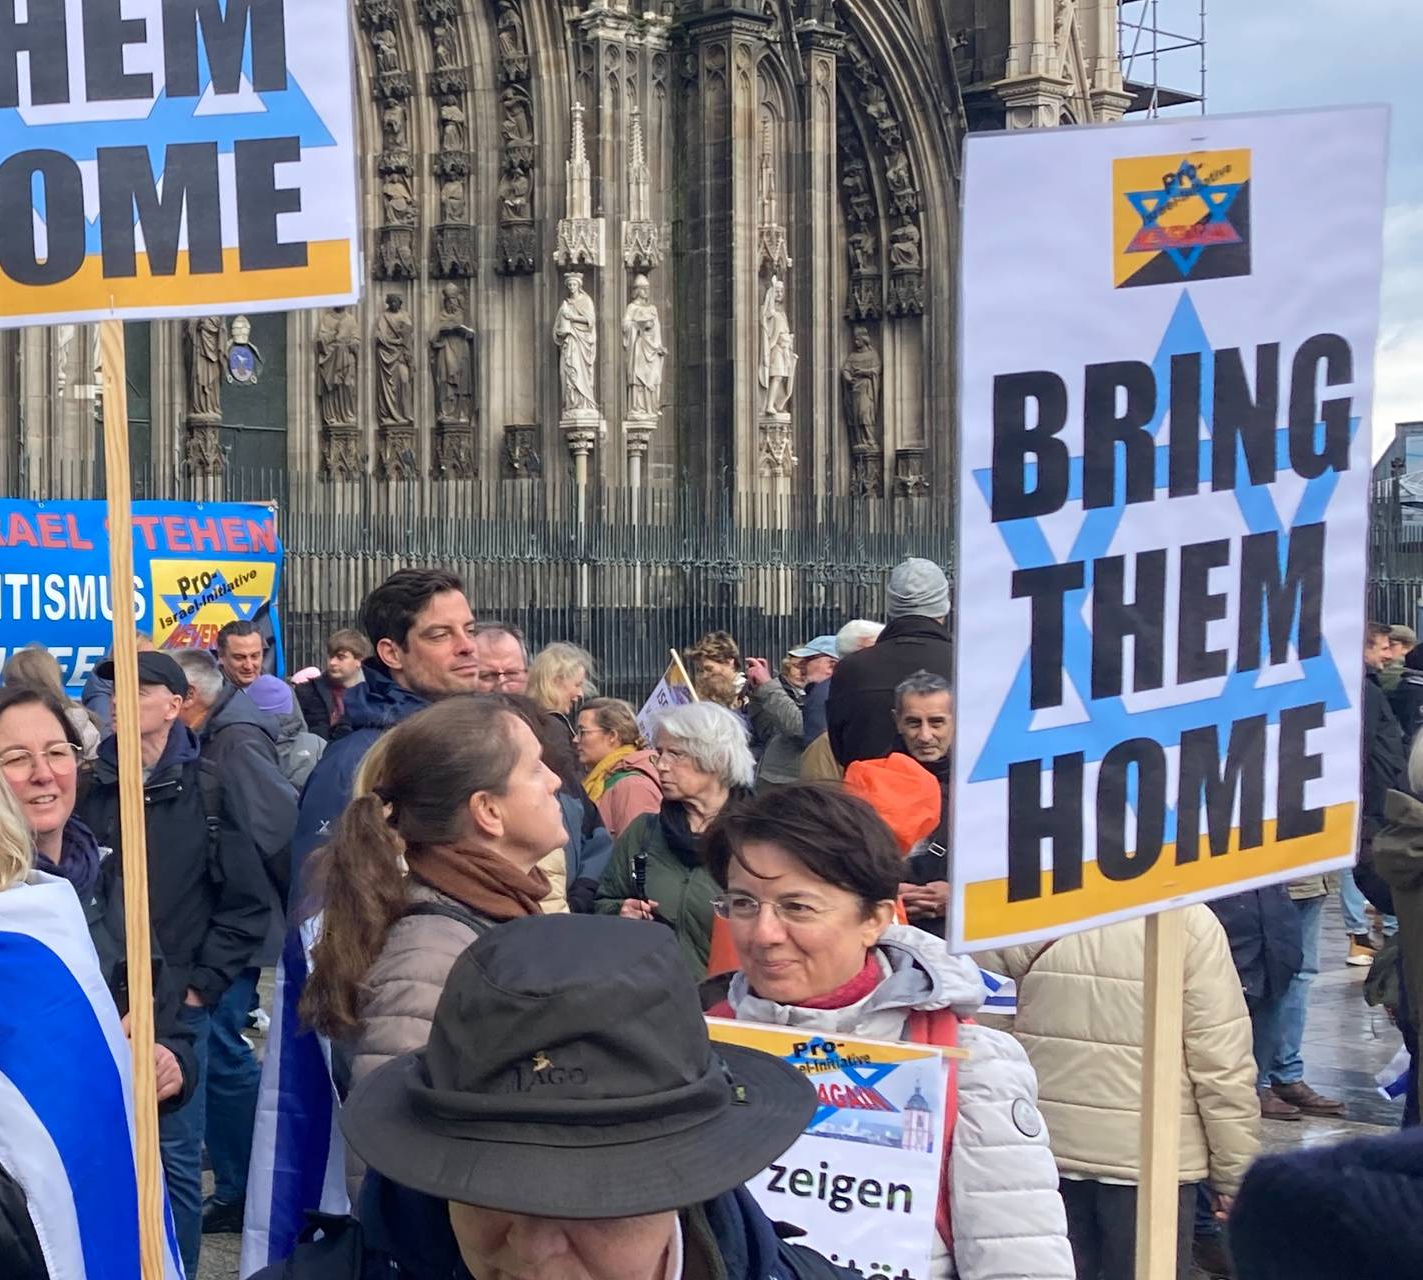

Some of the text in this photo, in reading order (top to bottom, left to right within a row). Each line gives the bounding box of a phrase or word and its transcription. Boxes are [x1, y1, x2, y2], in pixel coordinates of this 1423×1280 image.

[990, 333, 1354, 523] BRING
[104, 515, 276, 554] TEHEN
[159, 569, 257, 629] Israel-Initiative
[177, 571, 217, 600] Pro-
[1011, 522, 1326, 711] THEM
[1007, 702, 1325, 903] HOME
[793, 1041, 845, 1059] Pro-
[797, 1053, 871, 1076] el-Initiative
[767, 1161, 913, 1214] zeigen
